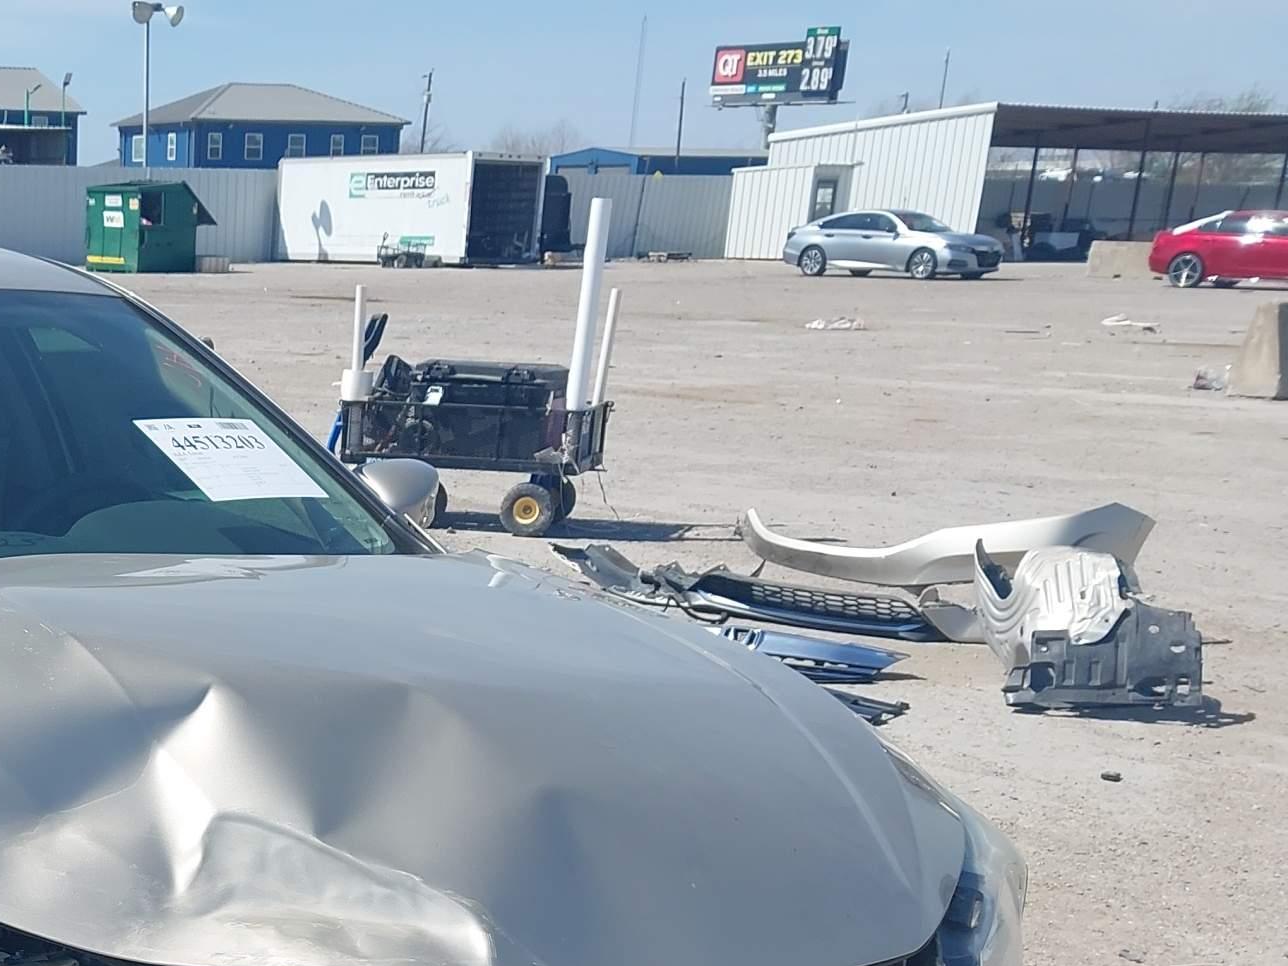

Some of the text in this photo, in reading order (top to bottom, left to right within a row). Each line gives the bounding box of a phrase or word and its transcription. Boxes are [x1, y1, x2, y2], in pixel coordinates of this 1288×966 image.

[718, 54, 741, 78] QT
[746, 51, 777, 66] EXIT
[778, 49, 803, 64] 273
[768, 67, 788, 77] MILES
[367, 173, 434, 190] Enterprise
[172, 435, 266, 451] 44513203
